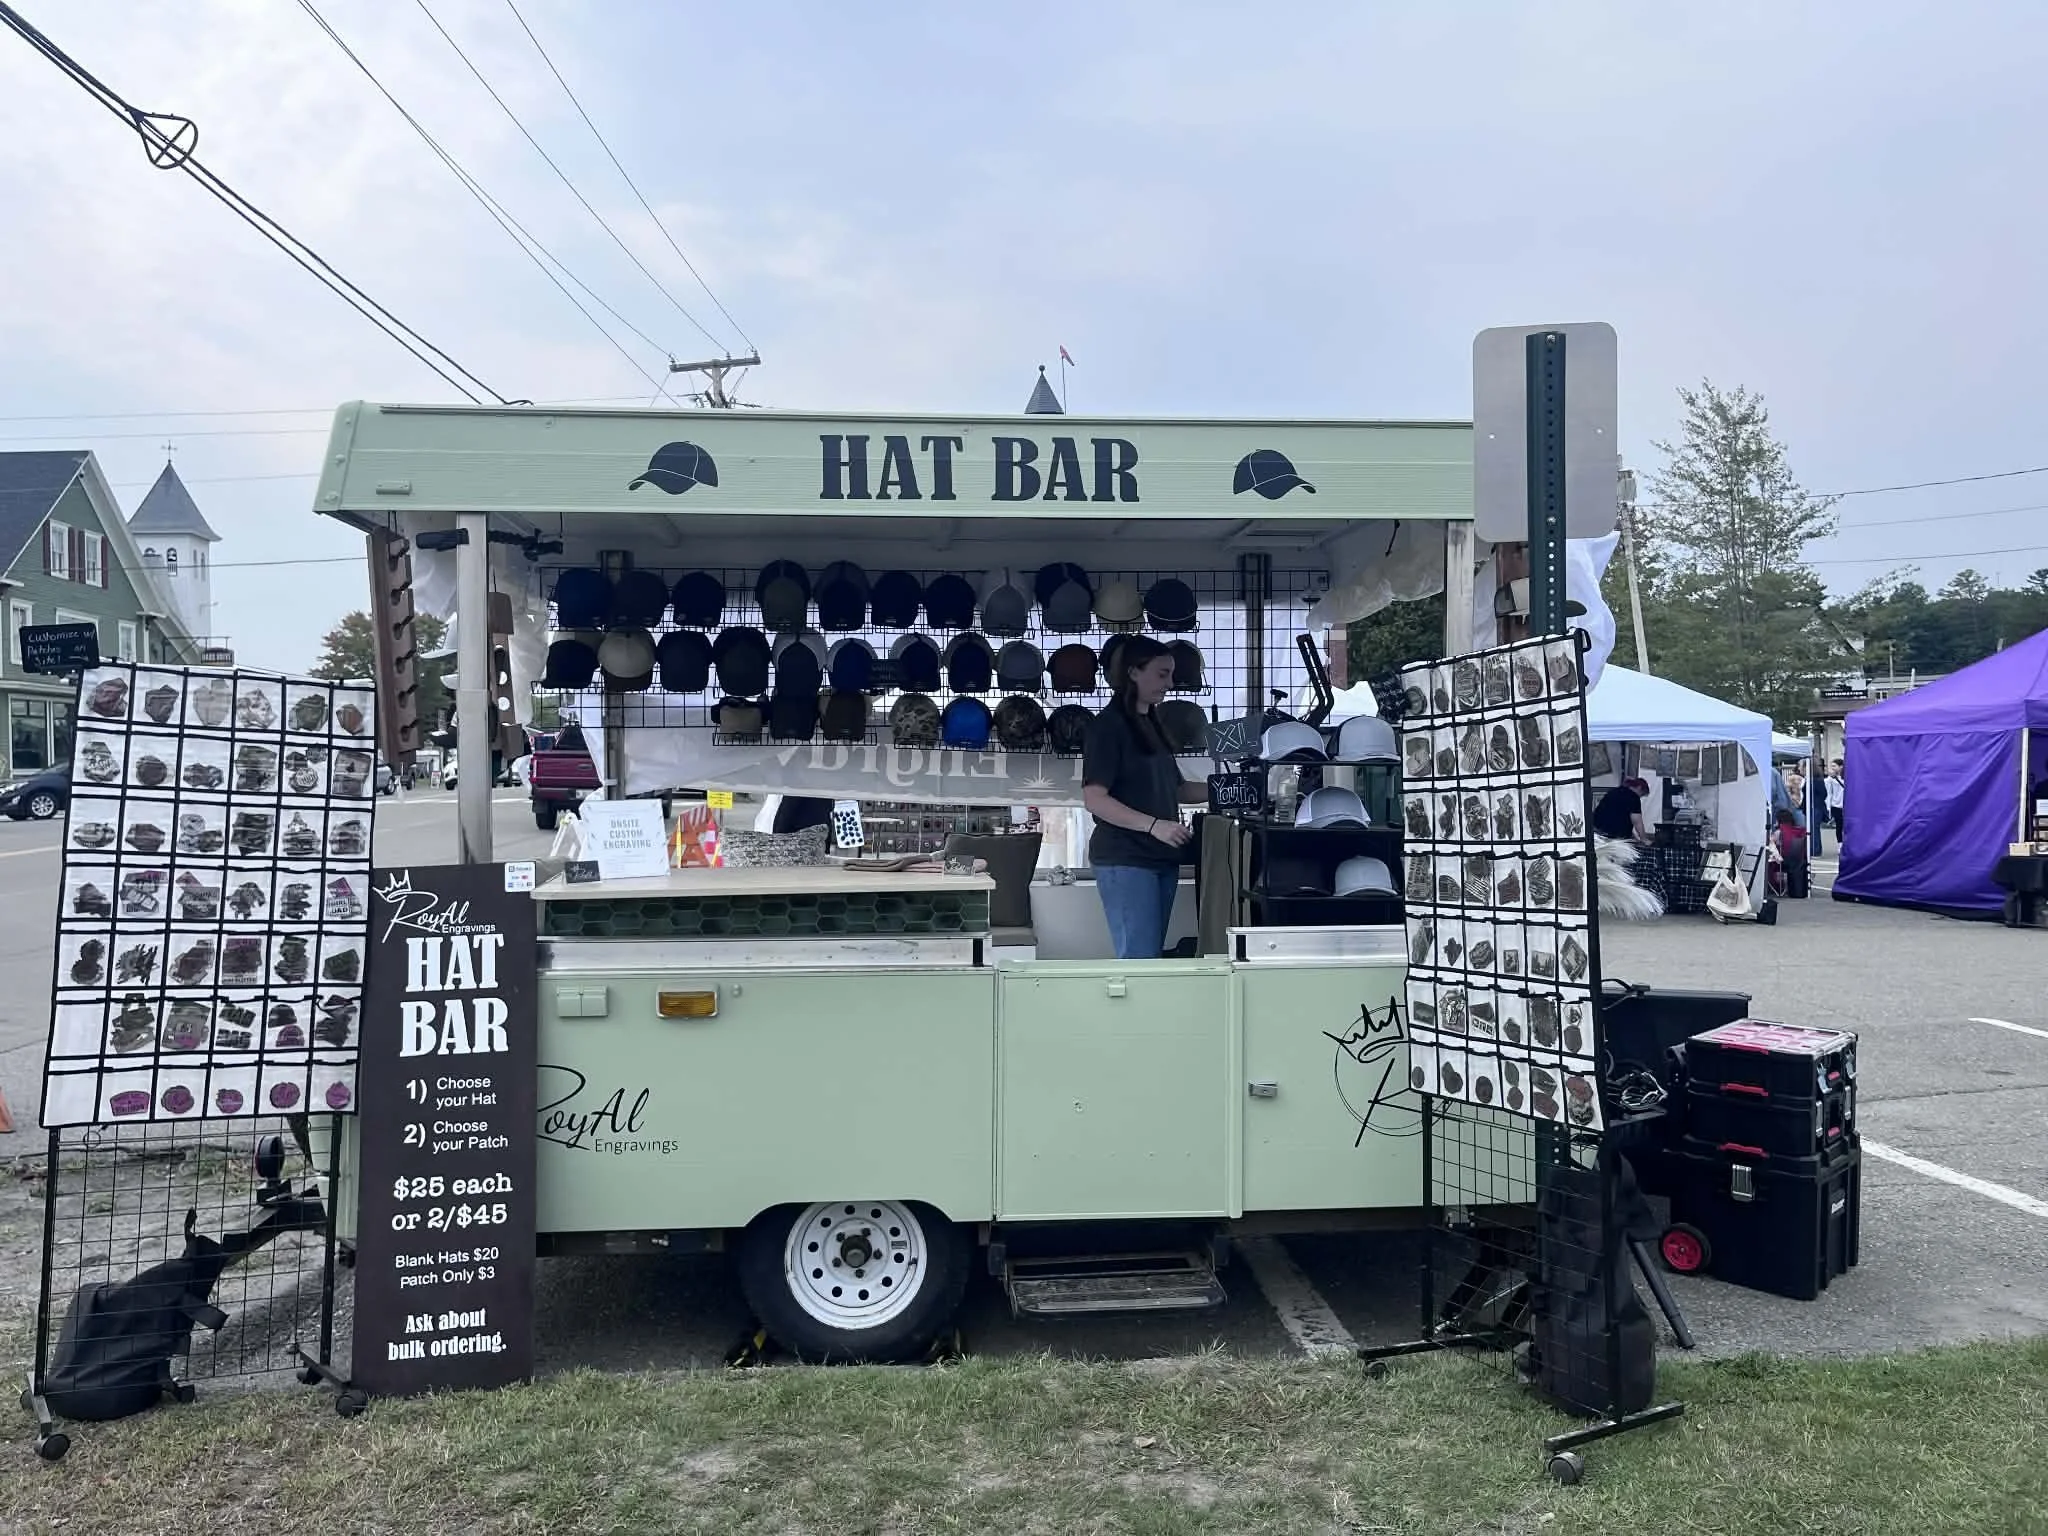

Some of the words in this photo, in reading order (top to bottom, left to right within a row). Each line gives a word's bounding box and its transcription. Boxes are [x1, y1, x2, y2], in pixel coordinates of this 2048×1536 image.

[819, 435, 963, 500] HAT
[991, 437, 1140, 502] BAR
[609, 829, 644, 839] CUSTOM
[610, 819, 640, 828] ONSITE
[603, 839, 652, 849] ENGRAVING
[442, 923, 496, 934] Engravings
[405, 934, 504, 992] HAT
[399, 997, 509, 1058] BAR
[406, 1079, 427, 1104] 1)
[436, 1077, 491, 1090] Choose
[436, 1096, 468, 1111] your
[471, 1092, 497, 1105] Hat
[403, 1123, 426, 1148] 2)
[433, 1120, 488, 1134] Choose
[432, 1139, 464, 1154] your
[468, 1135, 509, 1149] Patch
[595, 1138, 679, 1155] Engravings
[393, 1175, 445, 1201] $25
[452, 1172, 513, 1195] each
[391, 1212, 421, 1231] or
[427, 1203, 508, 1232] 2/$45
[395, 1252, 435, 1268] Blank
[438, 1250, 470, 1264] Hats
[473, 1246, 499, 1261] $20
[400, 1271, 438, 1288] Patch
[442, 1268, 475, 1284] Only
[478, 1265, 496, 1280] $3
[405, 1313, 434, 1334] Ask
[438, 1307, 486, 1331] about
[387, 1339, 426, 1361] bulk
[430, 1331, 507, 1356] ordering.
